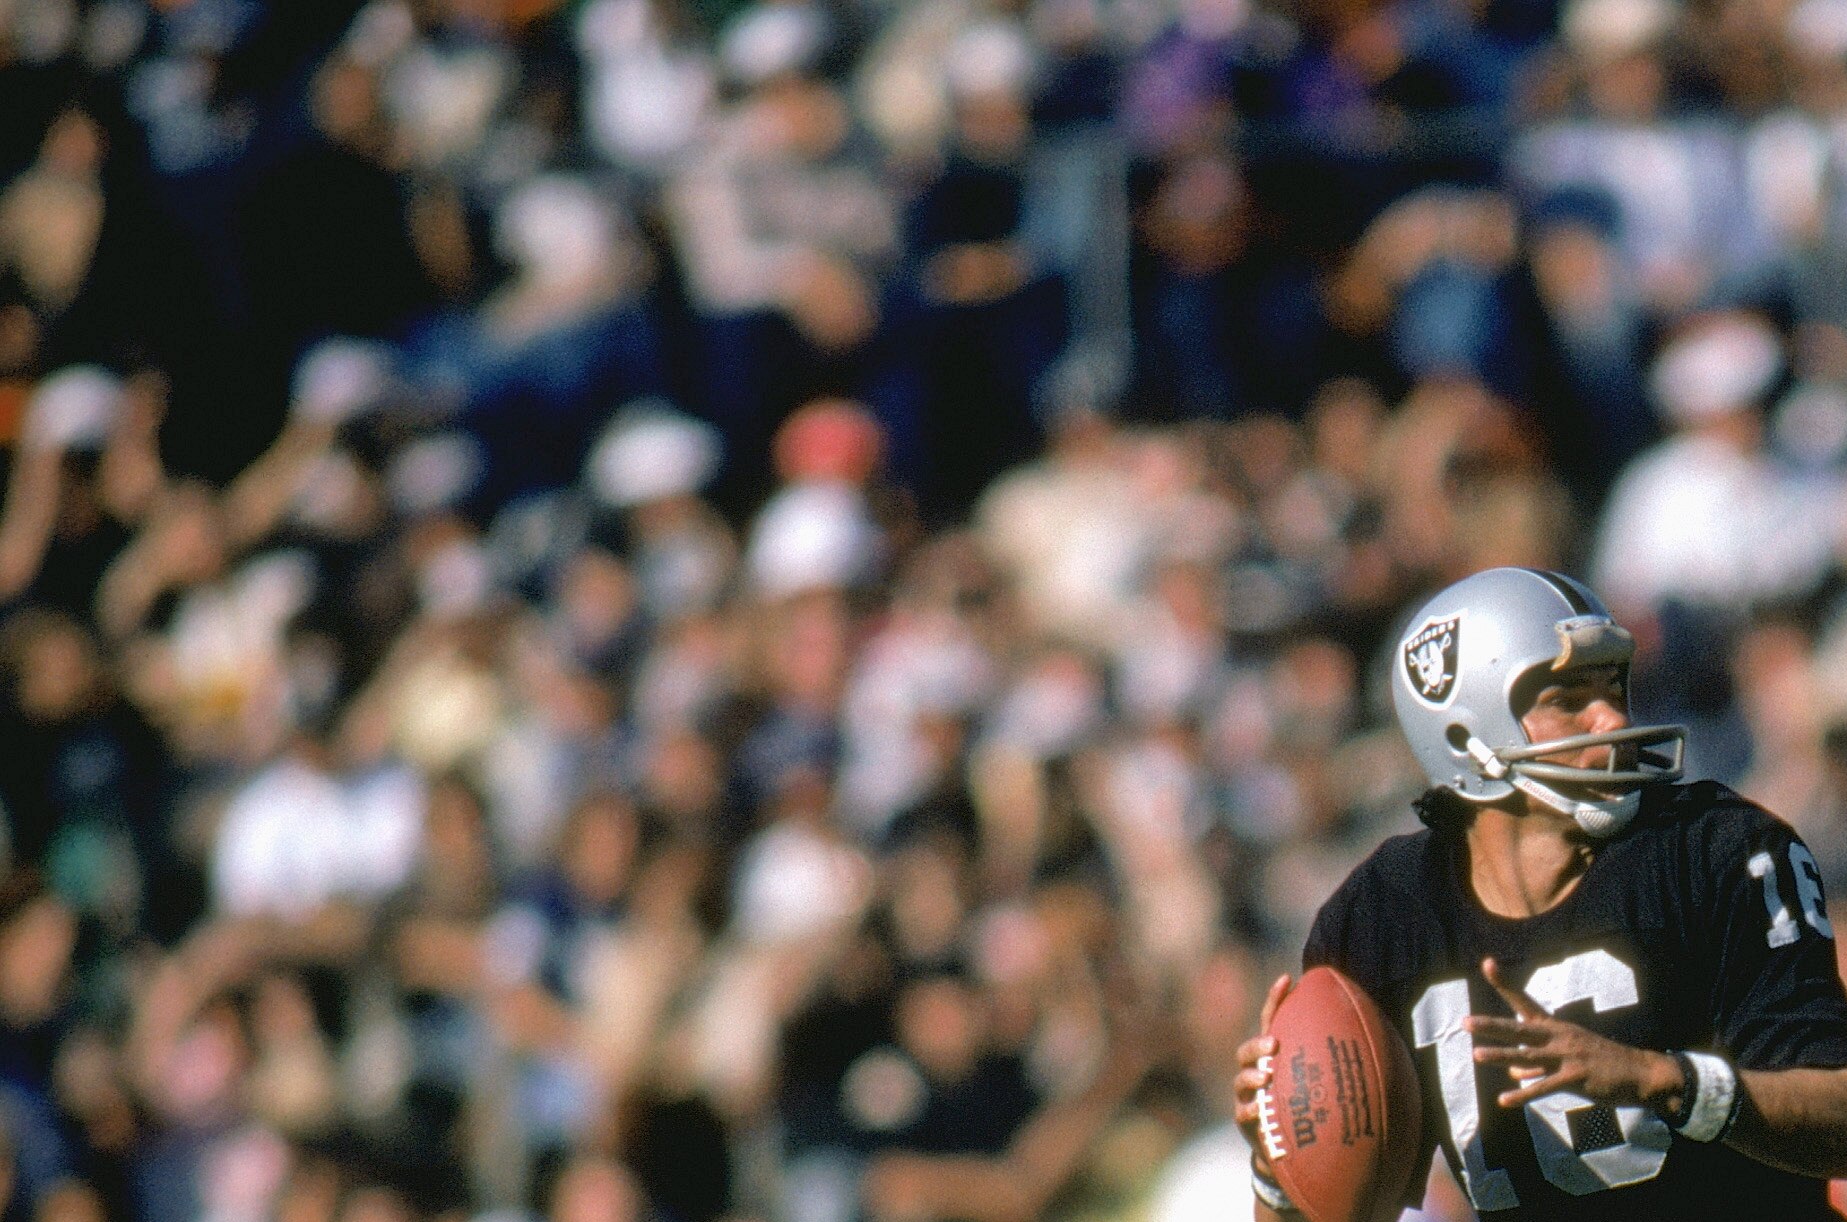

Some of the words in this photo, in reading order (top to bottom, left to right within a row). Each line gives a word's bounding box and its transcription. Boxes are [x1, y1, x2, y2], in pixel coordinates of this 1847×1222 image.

[1406, 620, 1456, 651] RAIDERS
[1289, 1046, 1317, 1148] Wilson
[1411, 949, 1672, 1212] 16
